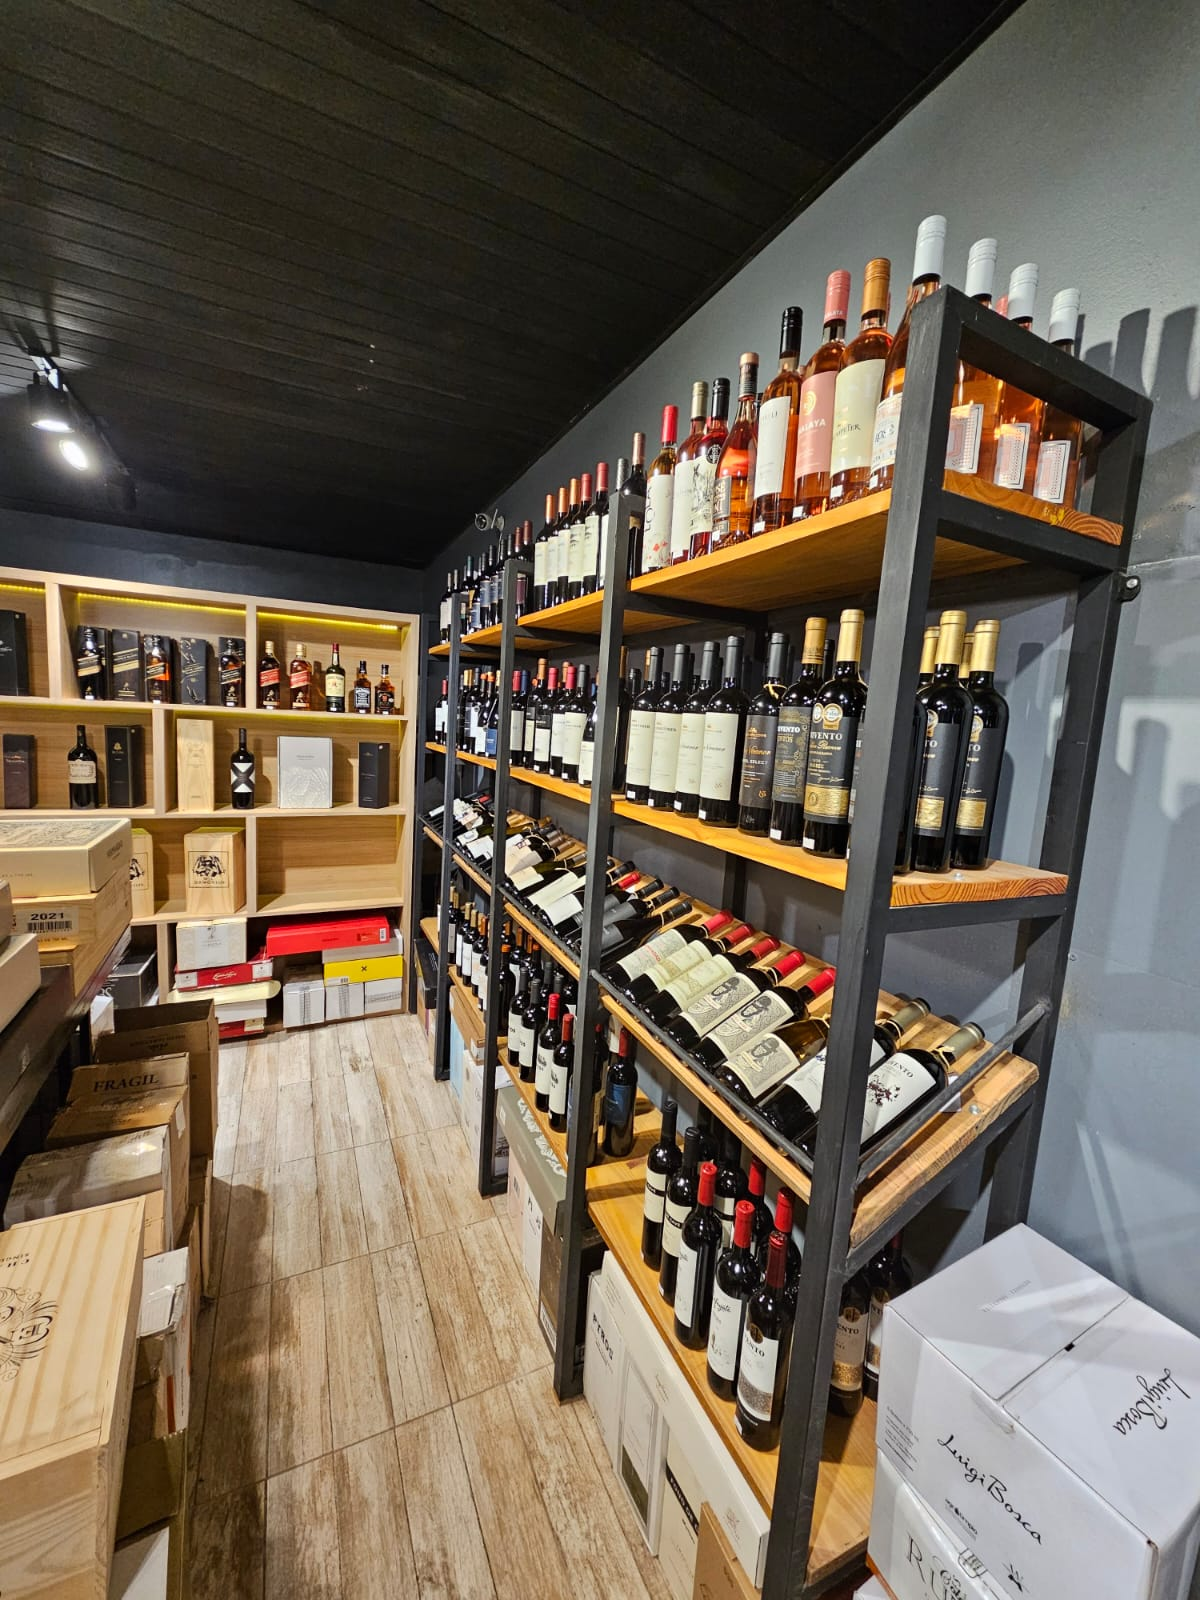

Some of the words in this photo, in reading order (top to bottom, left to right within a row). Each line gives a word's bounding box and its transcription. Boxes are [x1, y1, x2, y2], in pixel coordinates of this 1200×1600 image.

[30, 912, 65, 921] 2021
[93, 1074, 159, 1093] FRAGIL
[937, 1434, 988, 1487] Luigi
[986, 1474, 1042, 1545] Bosca
